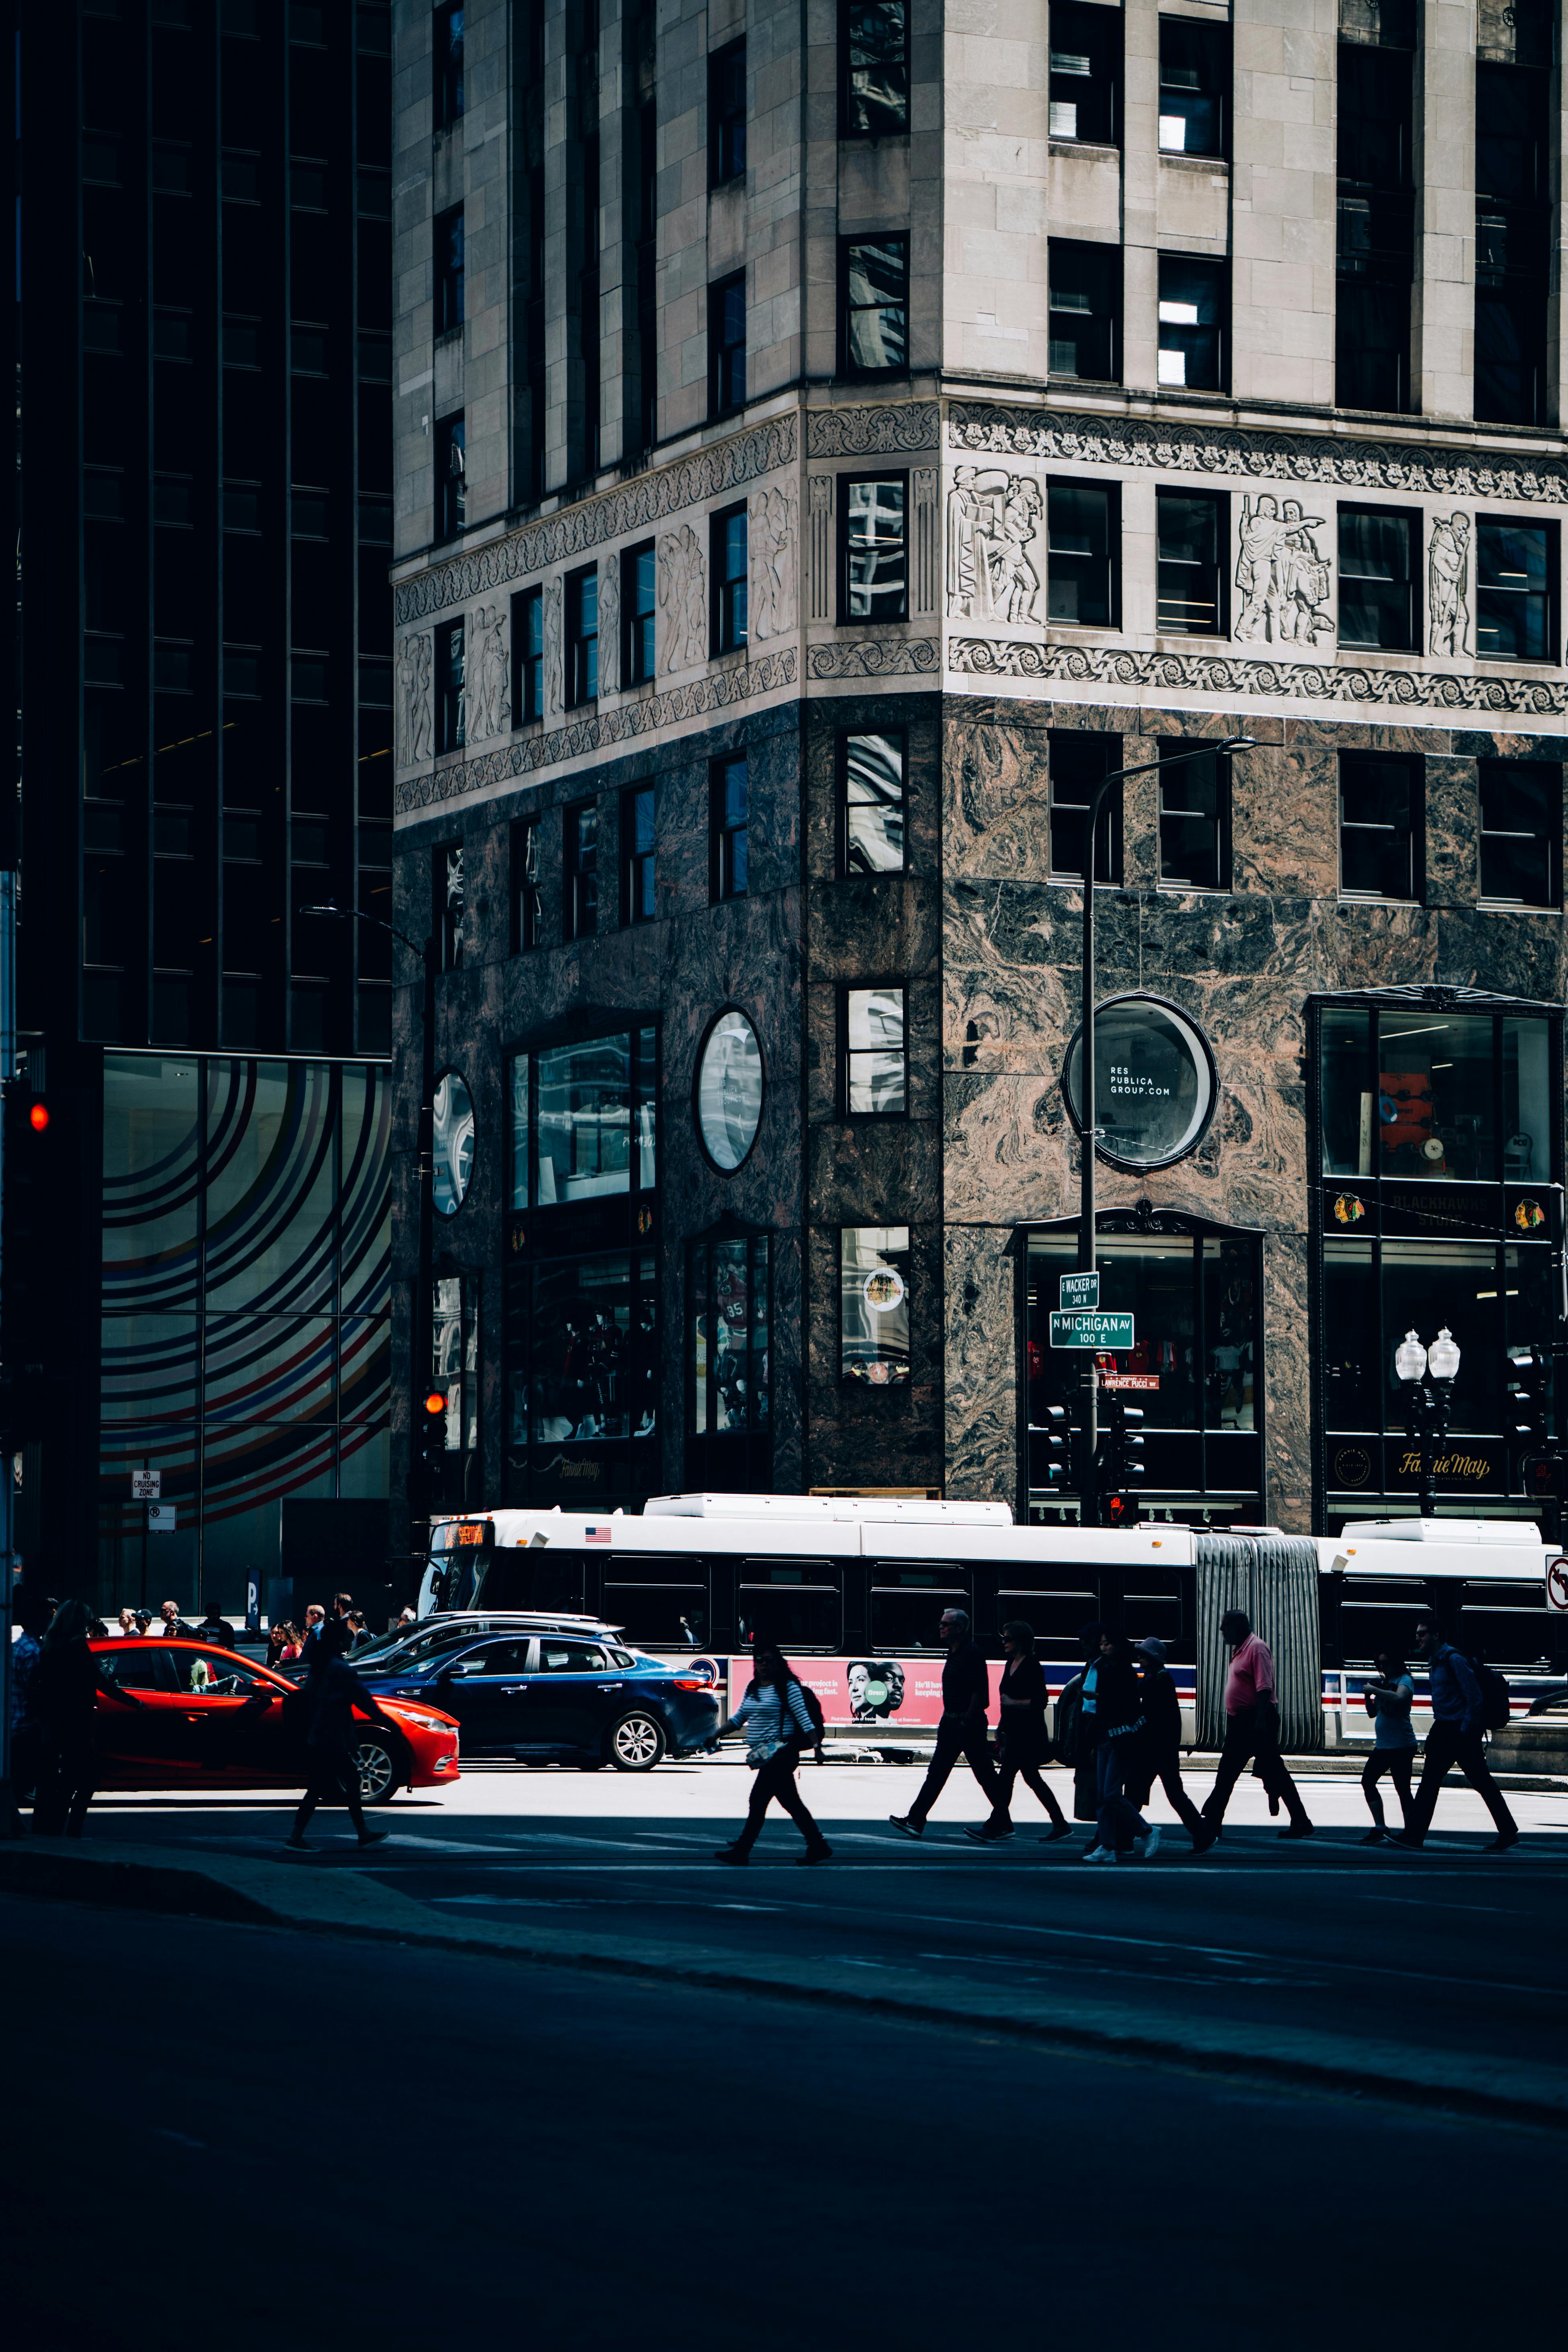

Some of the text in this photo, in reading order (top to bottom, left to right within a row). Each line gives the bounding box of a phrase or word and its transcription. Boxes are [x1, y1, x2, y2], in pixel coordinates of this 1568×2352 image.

[1111, 1067, 1128, 1075] RES
[1111, 1076, 1153, 1086] PUBLICA
[1110, 1086, 1170, 1096] GROUP.COM
[1393, 1195, 1487, 1211] BLACKHAWKS
[1418, 1213, 1463, 1227] STORE
[1062, 1278, 1097, 1293] E WACKER DR
[1072, 1294, 1087, 1305] 340 N
[727, 1302, 743, 1318] 95
[1054, 1317, 1130, 1332] N MICHIGAN AV
[1080, 1333, 1106, 1343] 100 E
[559, 1458, 600, 1482] Fannie May
[1451, 1453, 1490, 1480] May
[248, 1581, 257, 1614] P
[809, 1679, 831, 1688] project
[915, 1689, 941, 1698] keeping
